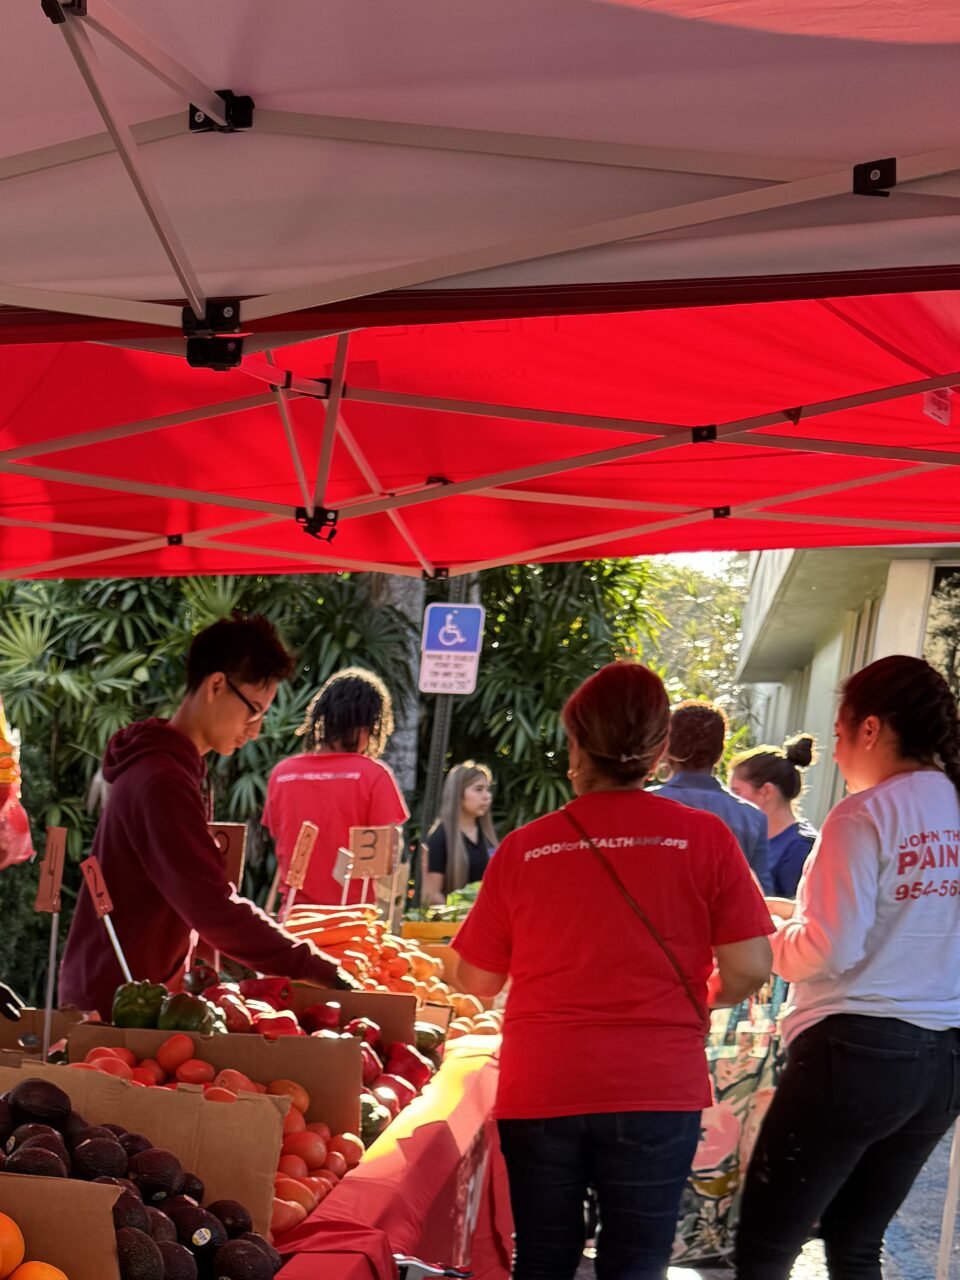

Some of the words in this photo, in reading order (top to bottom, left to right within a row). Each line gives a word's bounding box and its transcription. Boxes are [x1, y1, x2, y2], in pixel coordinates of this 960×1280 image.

[360, 829, 377, 861] 3
[898, 831, 940, 849] JOHN
[897, 844, 959, 876] PAIN
[895, 879, 960, 902] 954-56
